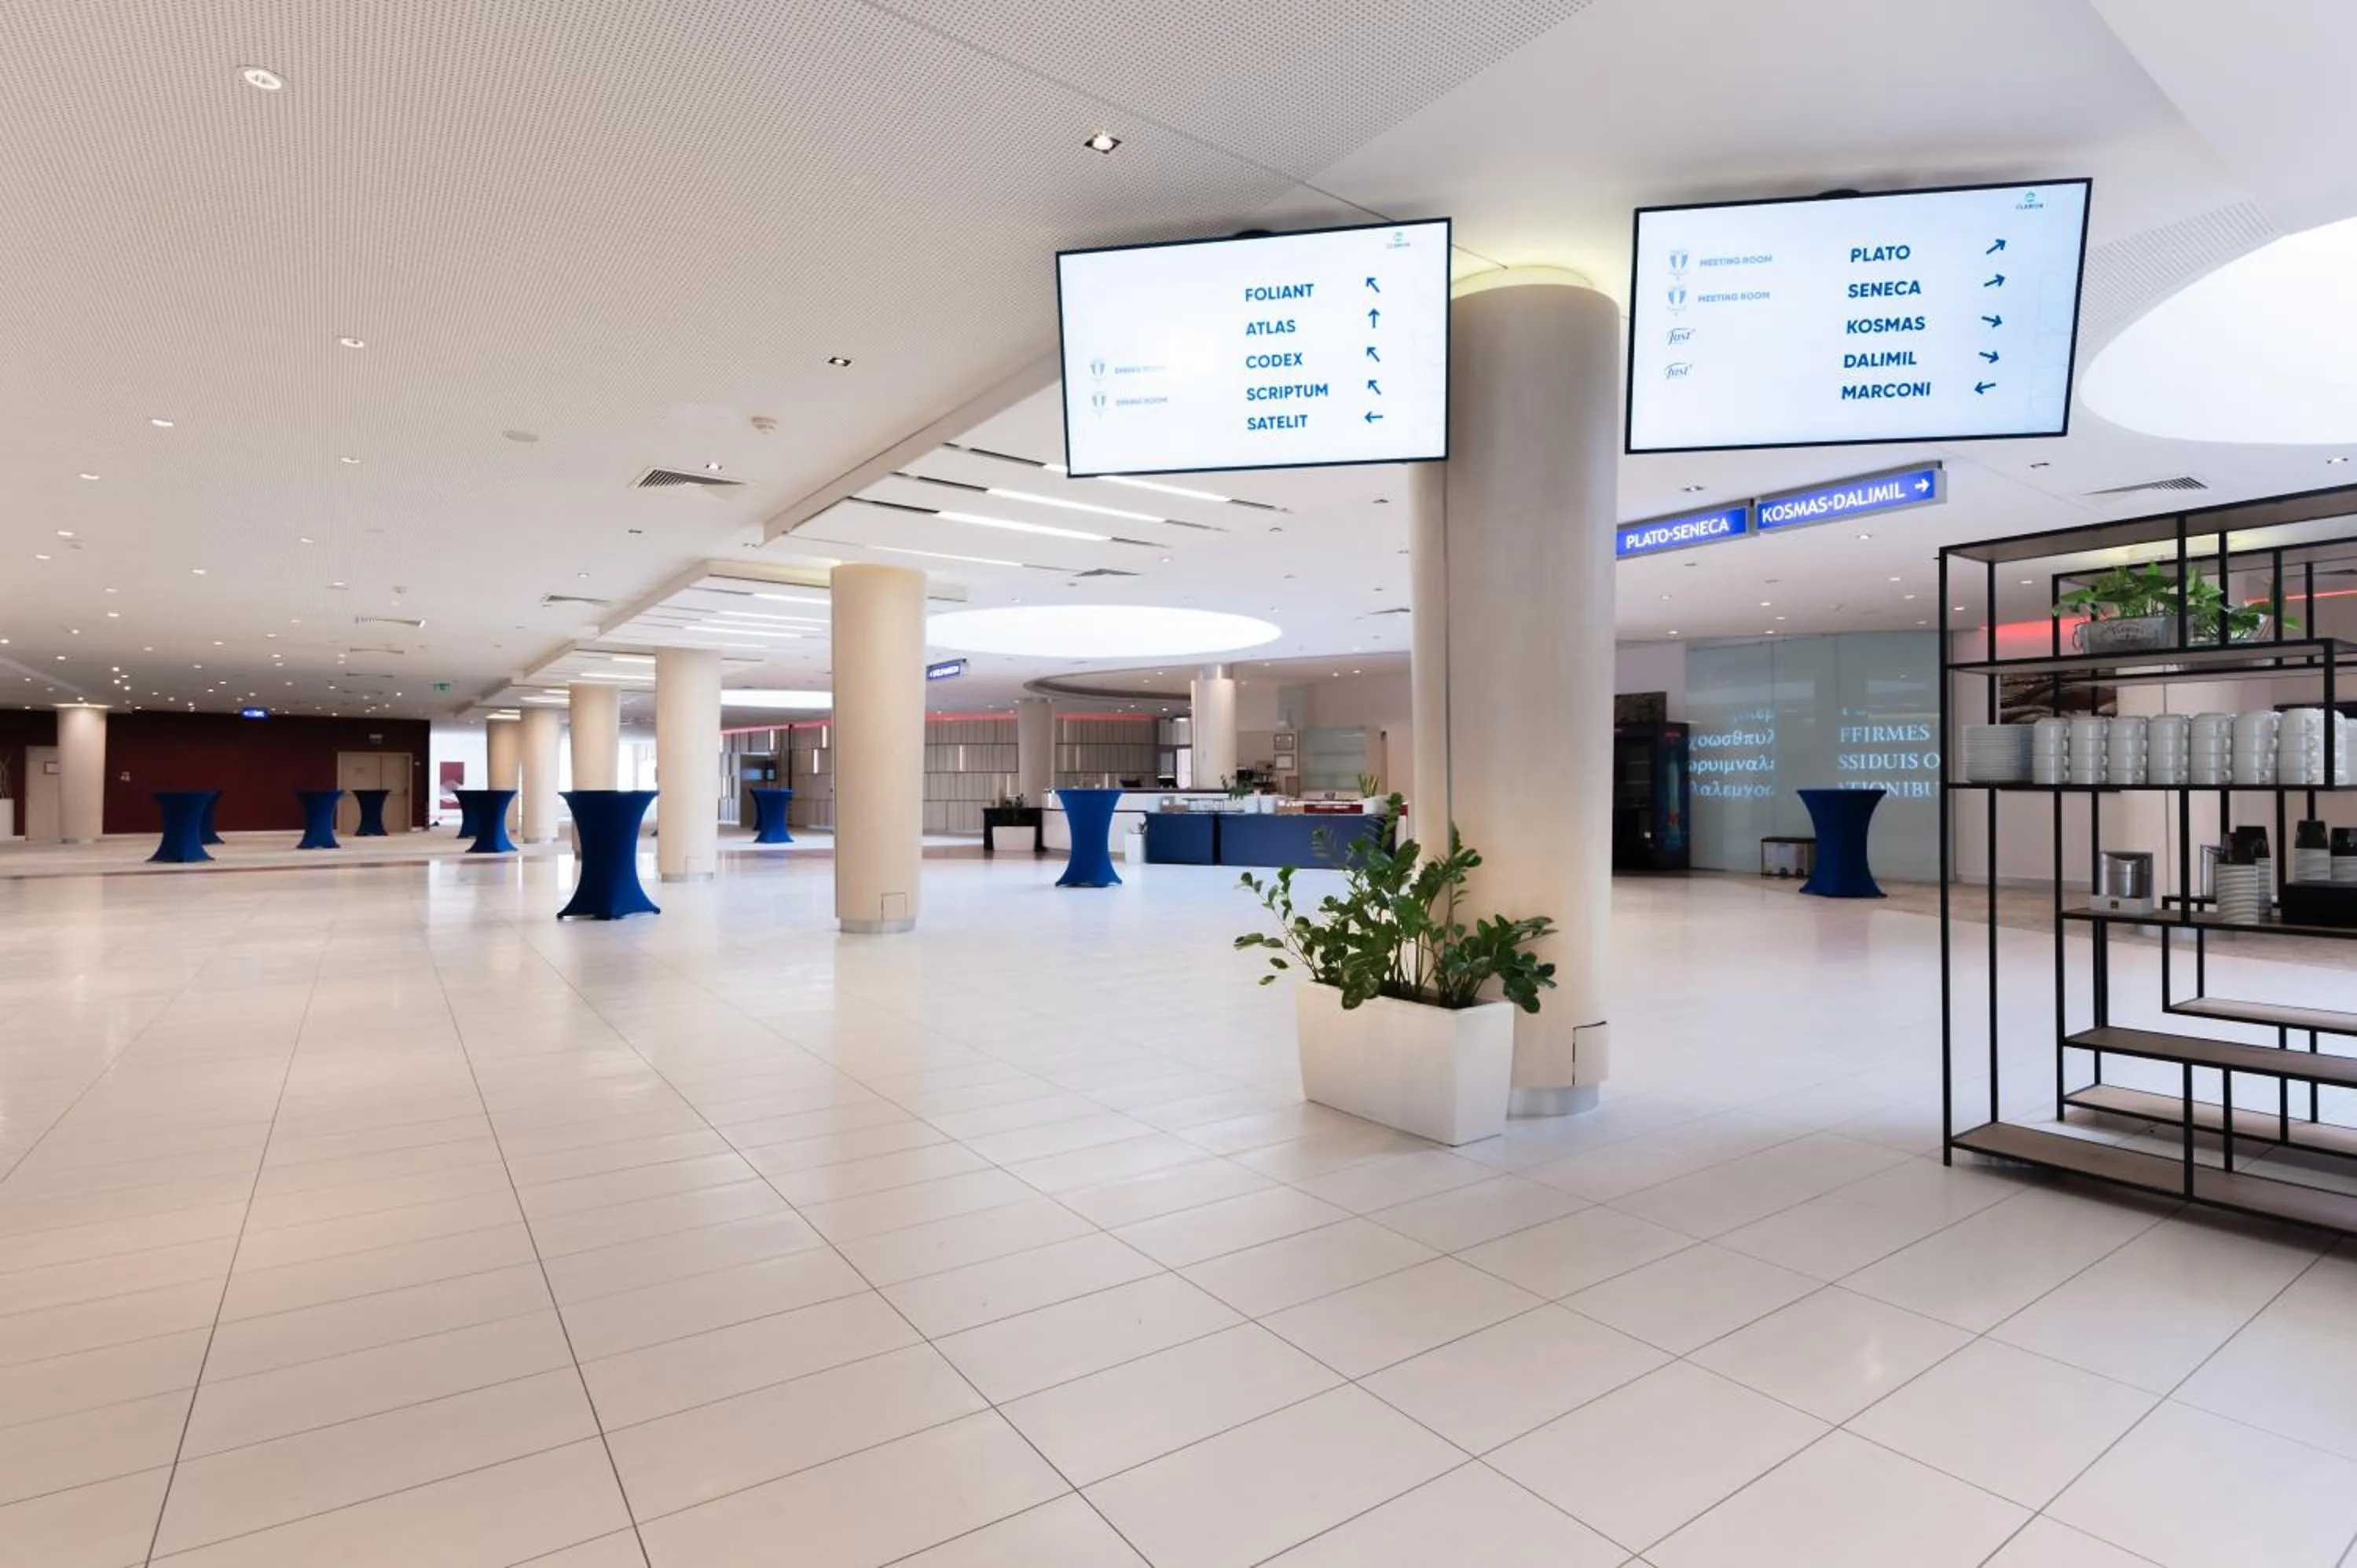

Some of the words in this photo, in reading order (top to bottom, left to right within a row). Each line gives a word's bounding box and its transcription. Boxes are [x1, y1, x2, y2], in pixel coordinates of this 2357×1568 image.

[1699, 257, 1740, 268] MEETING
[1742, 253, 1773, 265] ROOM
[1850, 244, 1911, 263] PLATO
[1244, 283, 1314, 302] FOLIANT
[1698, 293, 1738, 302] MEETING
[1740, 291, 1770, 300] ROOM
[1847, 280, 1922, 299] SENECA
[1245, 319, 1296, 335] ATLAS
[1846, 316, 1926, 334] KOSMAS
[1245, 352, 1303, 368] CODEX
[1843, 351, 1917, 368] DALIMIL
[1246, 383, 1329, 401] SCRIPTUM
[1841, 381, 1931, 400] MARCONI
[1247, 414, 1308, 430] SATELIT
[1837, 753, 1919, 771] SSIDUIS
[1923, 752, 1941, 770] O
